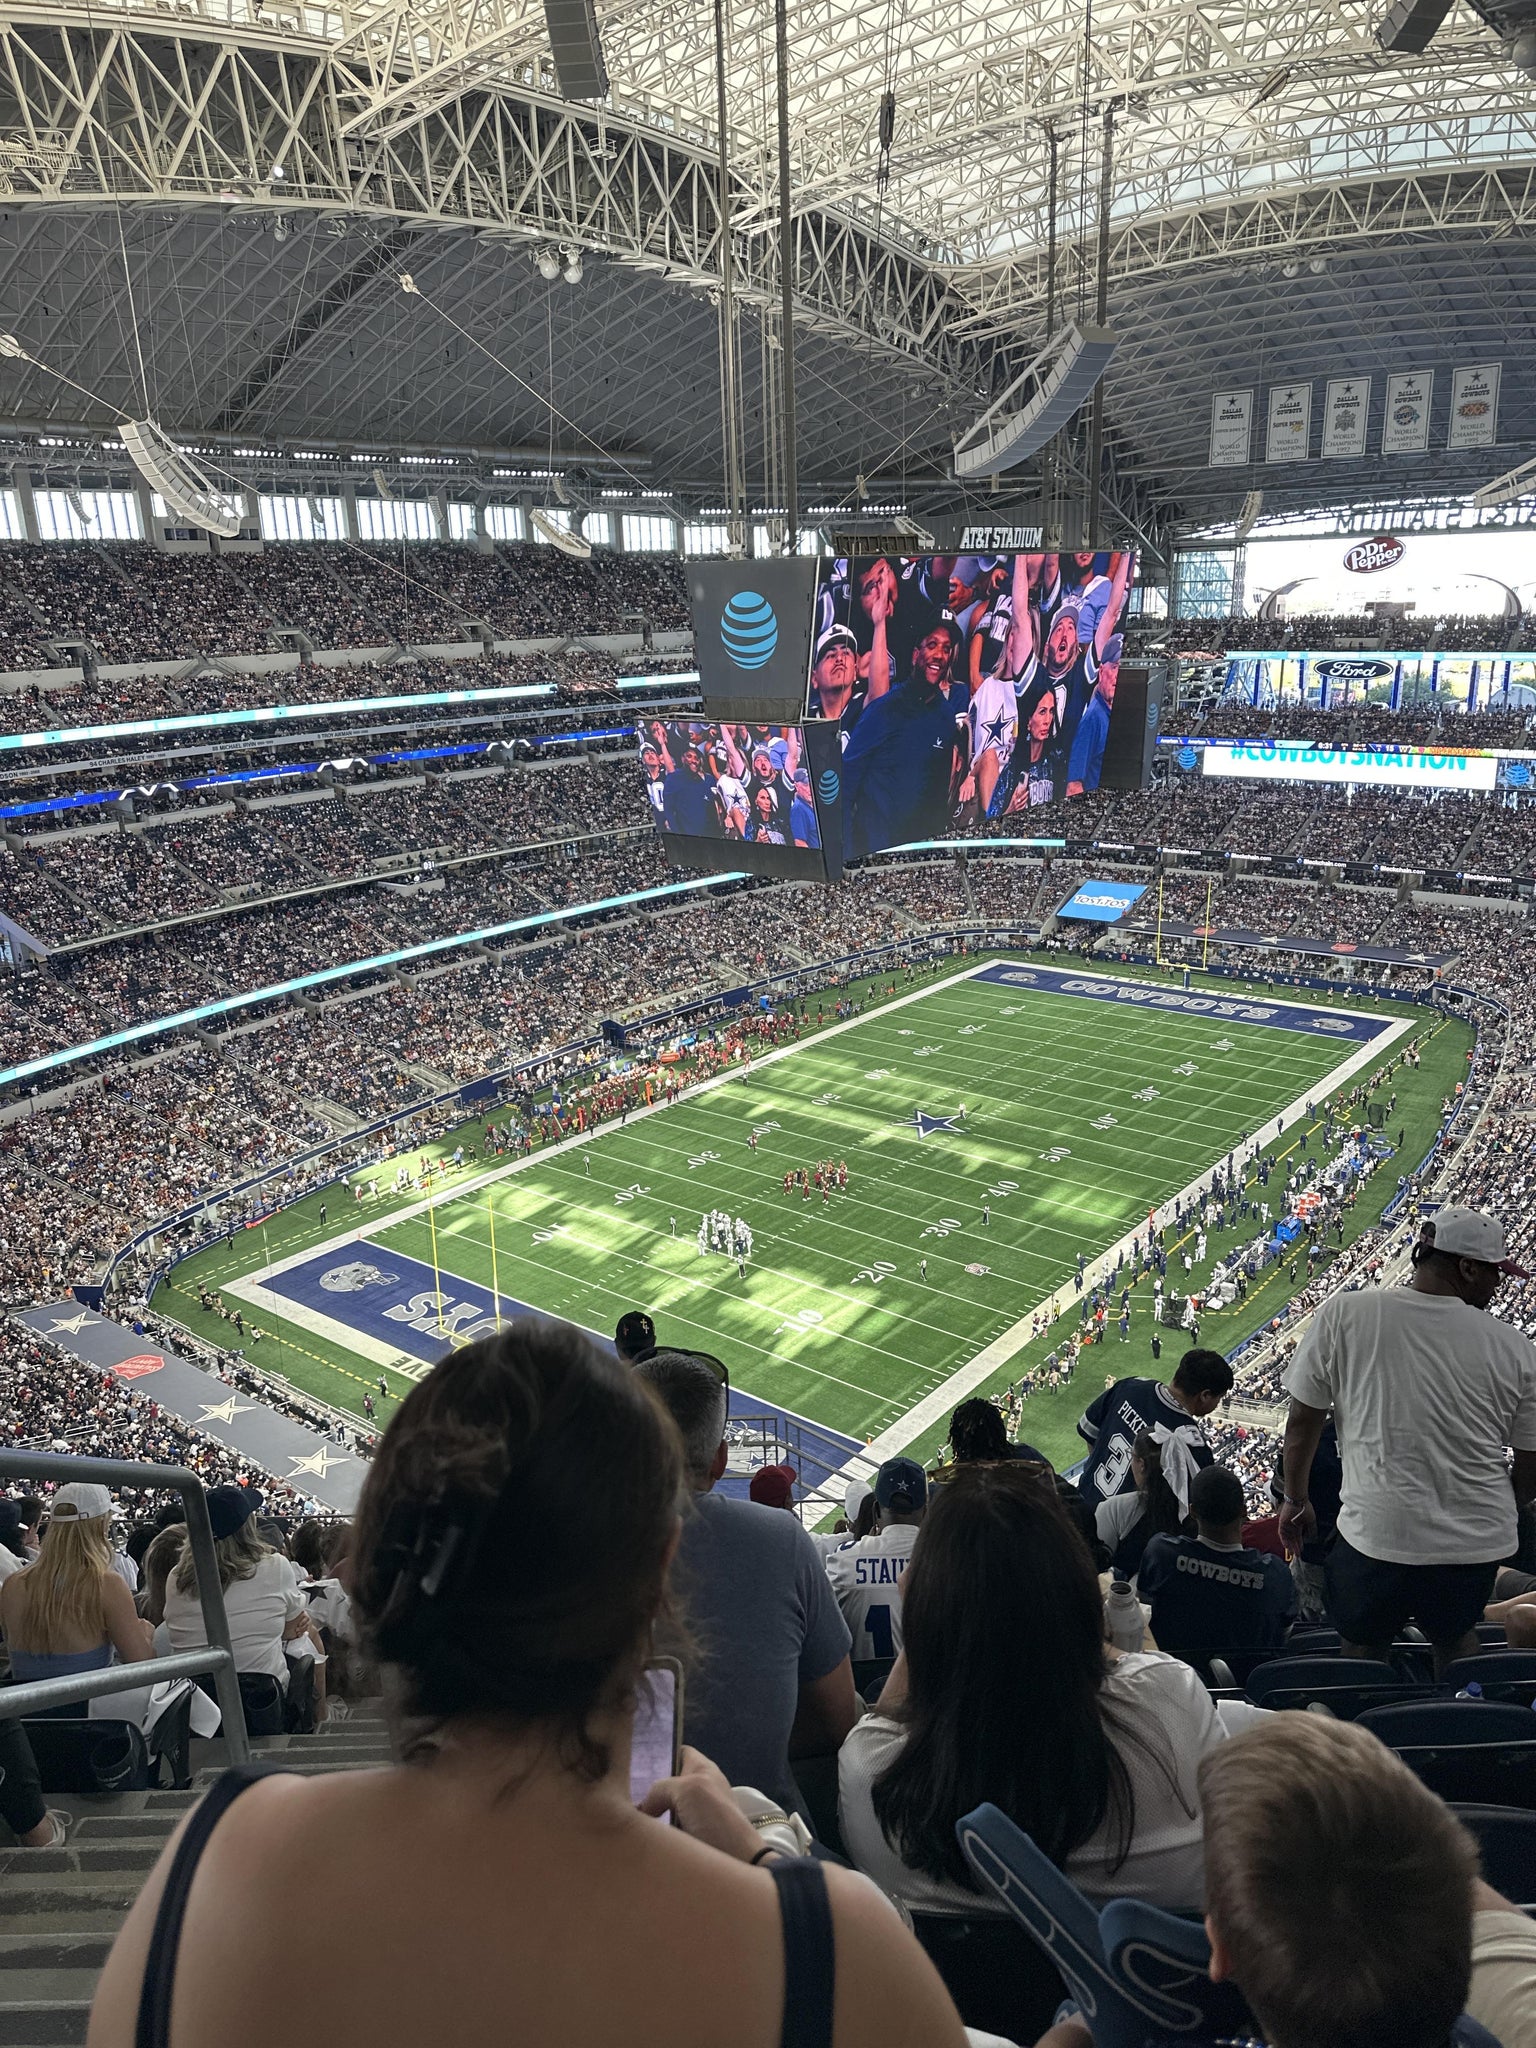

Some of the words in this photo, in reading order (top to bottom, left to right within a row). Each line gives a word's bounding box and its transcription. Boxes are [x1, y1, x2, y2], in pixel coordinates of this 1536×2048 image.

[1461, 390, 1490, 398] COWBOYS
[960, 527, 992, 549] AT&T
[992, 527, 1043, 548] STADIUM
[1351, 546, 1402, 570] Pepper
[1366, 542, 1387, 557] Dr
[1329, 662, 1376, 676] Ford
[98, 758, 126, 766] CHARLES
[1231, 747, 1466, 770] #COWBOYSNATION
[1304, 859, 1347, 868] Blockchain.com
[1380, 865, 1426, 875] Blockchain.com
[1464, 873, 1512, 882] Blockchain.com
[1060, 980, 1279, 1020] COWBOYS
[1172, 1062, 1200, 1076] 20
[811, 1092, 842, 1106] 50
[1132, 1088, 1160, 1102] 30
[752, 1120, 782, 1134] 40
[1090, 1115, 1118, 1130] 40
[687, 1150, 722, 1166] 30
[1038, 1146, 1072, 1163] 50
[614, 1183, 652, 1201] 20
[988, 1180, 1020, 1198] 40
[532, 1222, 571, 1242] 10
[925, 1218, 962, 1238] 30
[858, 1261, 897, 1284] 20
[782, 1309, 824, 1335] 10
[1117, 1400, 1148, 1435] PICKE
[1094, 1432, 1134, 1498] 3
[856, 1558, 910, 1584] STAU
[1176, 1554, 1264, 1590] COWBOYS
